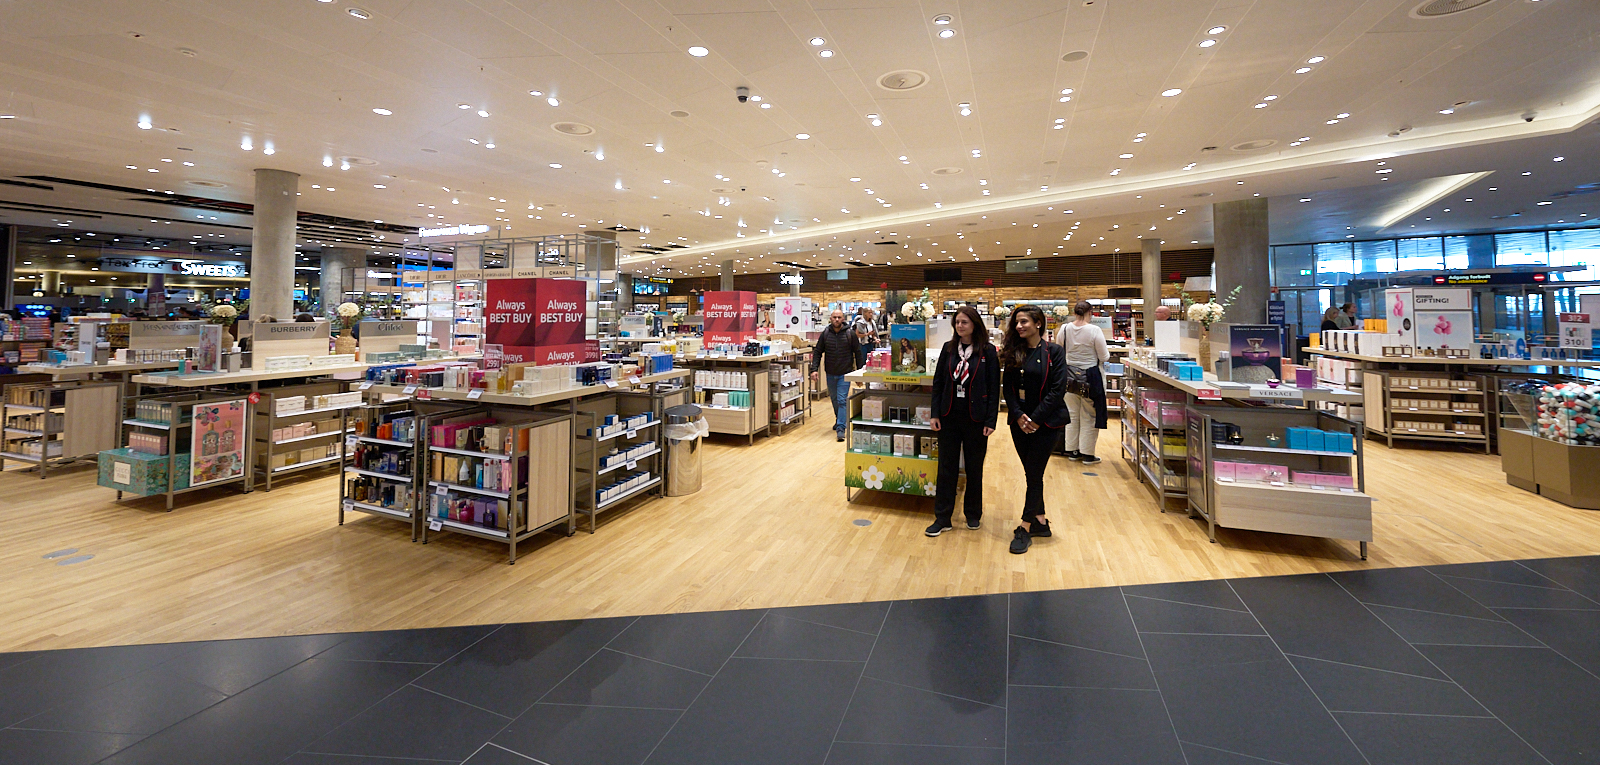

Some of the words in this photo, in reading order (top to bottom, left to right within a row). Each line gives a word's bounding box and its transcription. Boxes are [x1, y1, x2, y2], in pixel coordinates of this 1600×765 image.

[496, 300, 525, 312] Always
[547, 300, 577, 311] Always
[490, 313, 512, 323] BEST
[513, 313, 532, 323] BUY
[541, 313, 563, 323] BEST
[565, 312, 583, 323] BUY
[502, 353, 523, 362] ways
[547, 351, 574, 361] Always
